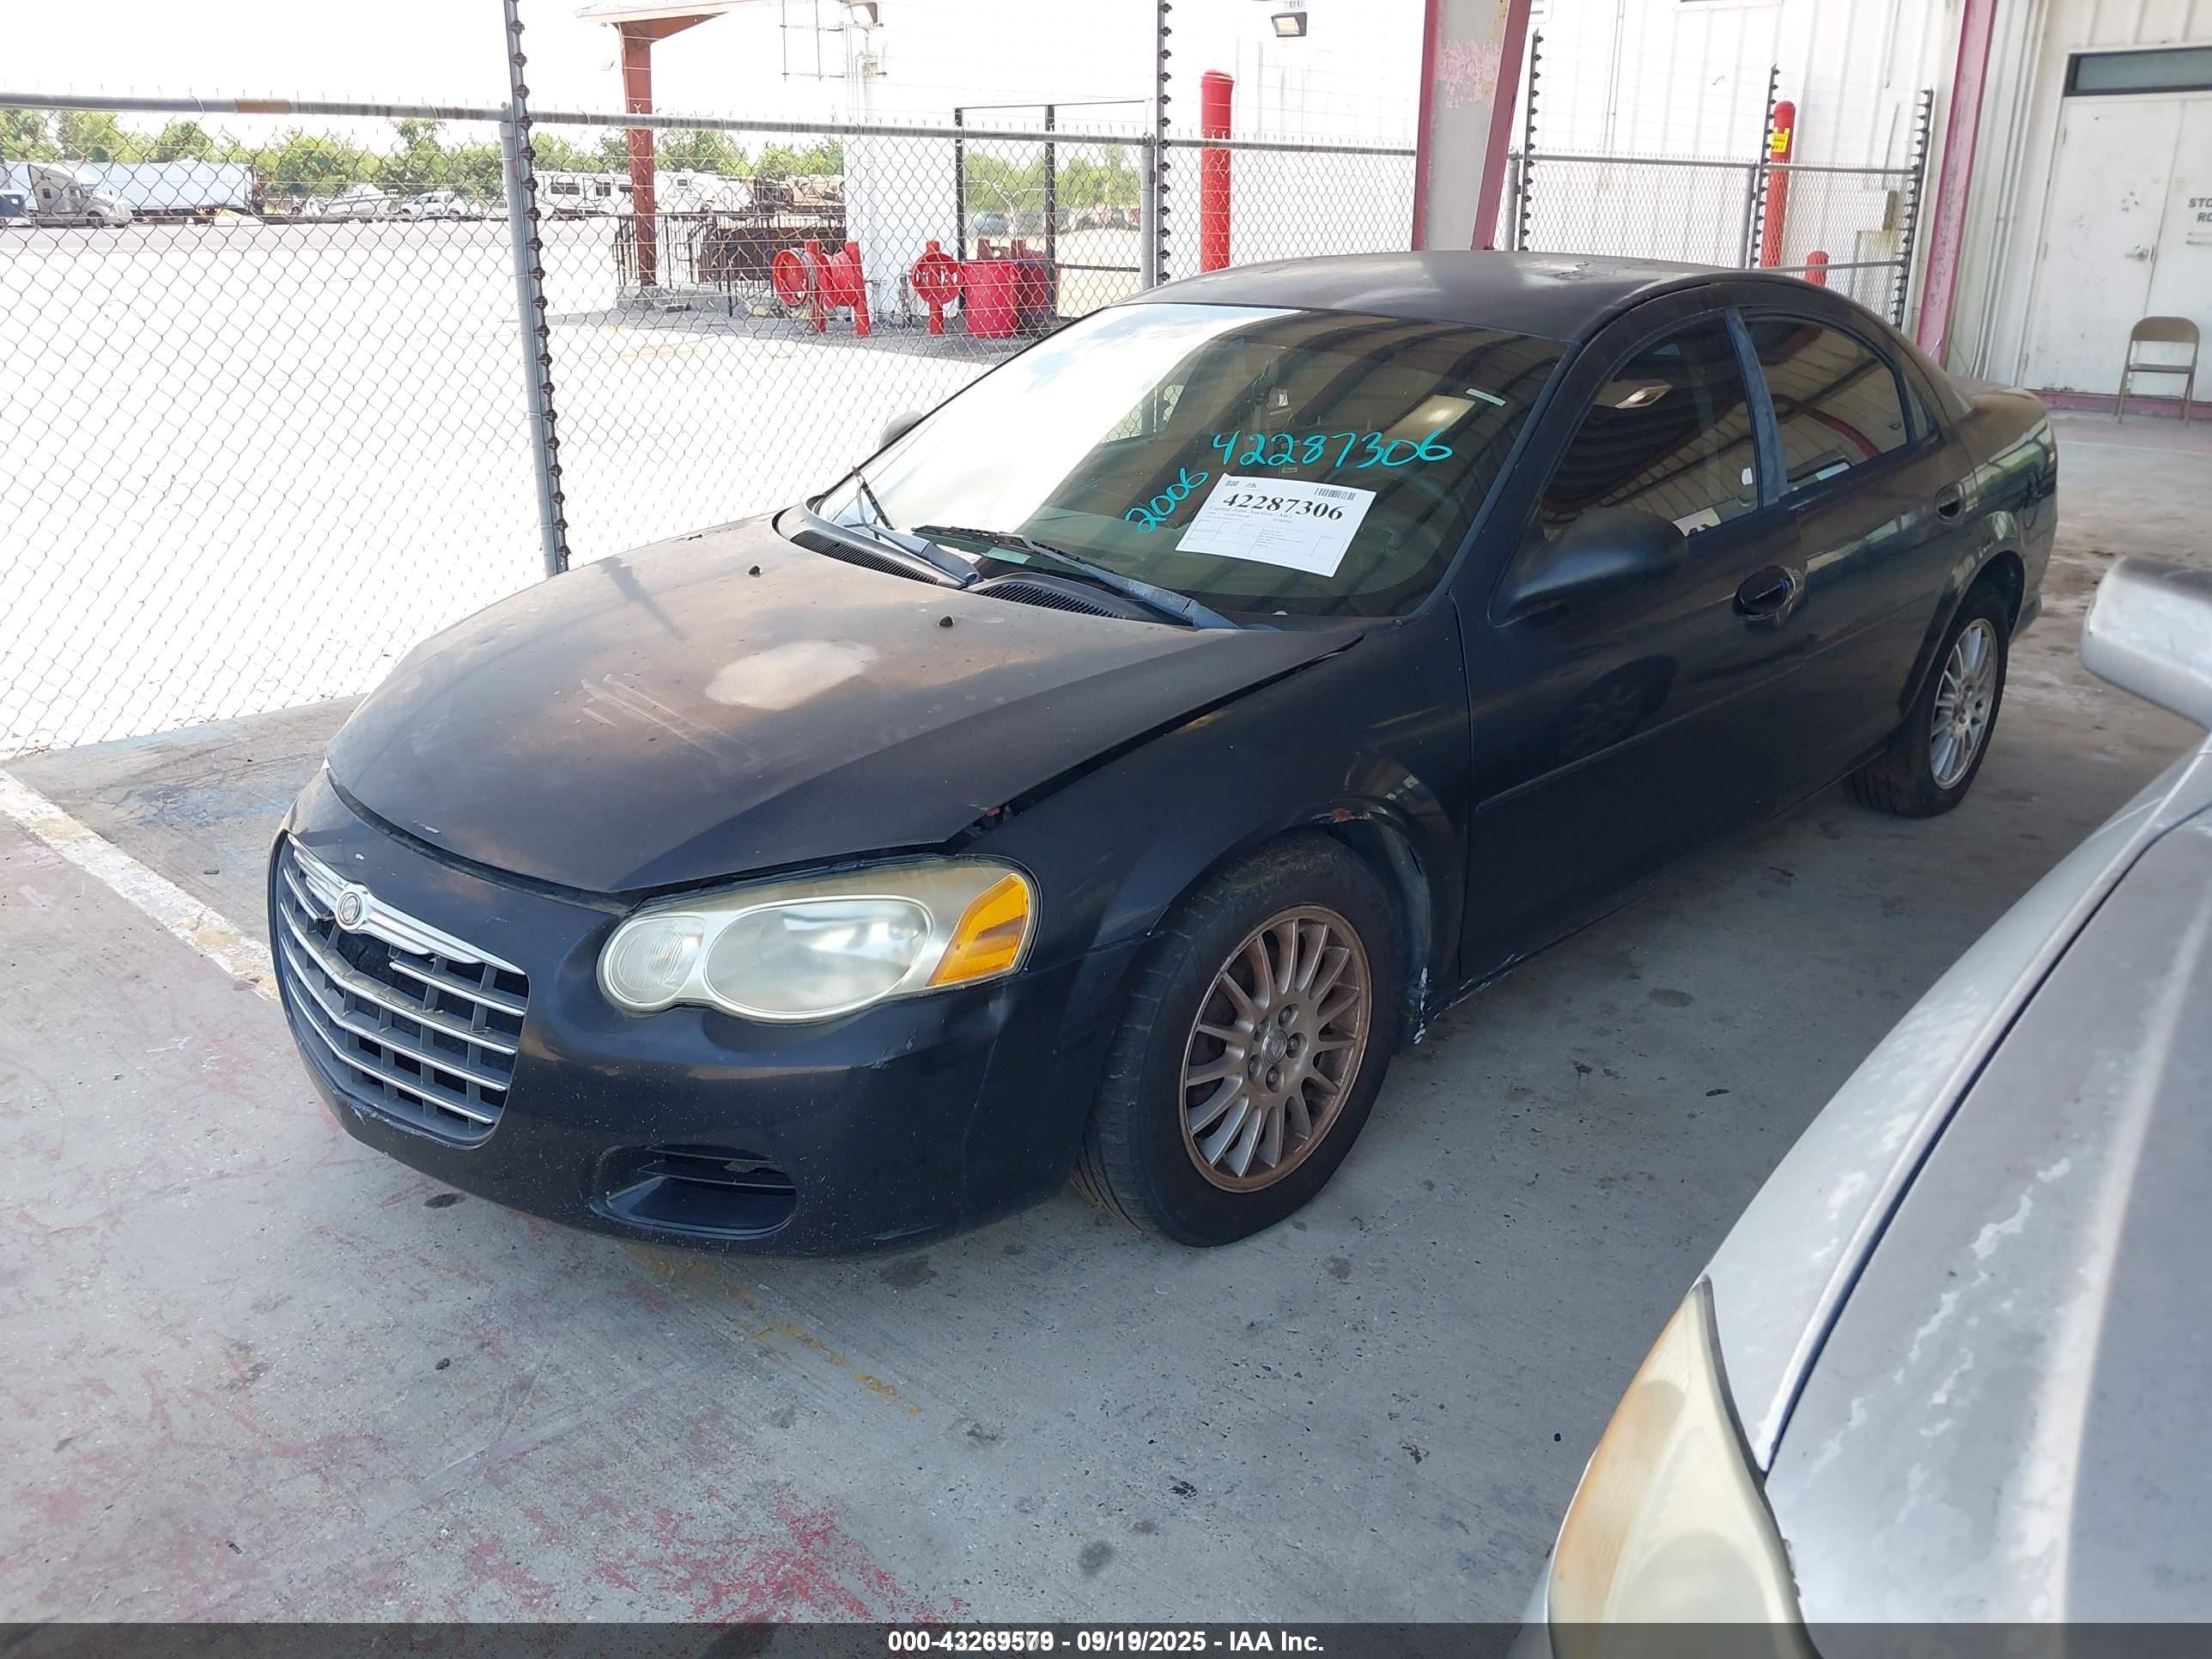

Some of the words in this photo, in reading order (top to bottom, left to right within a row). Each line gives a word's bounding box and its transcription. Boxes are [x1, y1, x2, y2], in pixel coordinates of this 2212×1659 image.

[1212, 430, 1453, 469] 42287306
[1125, 467, 1208, 534] 2006
[1223, 493, 1346, 520] 42287306
